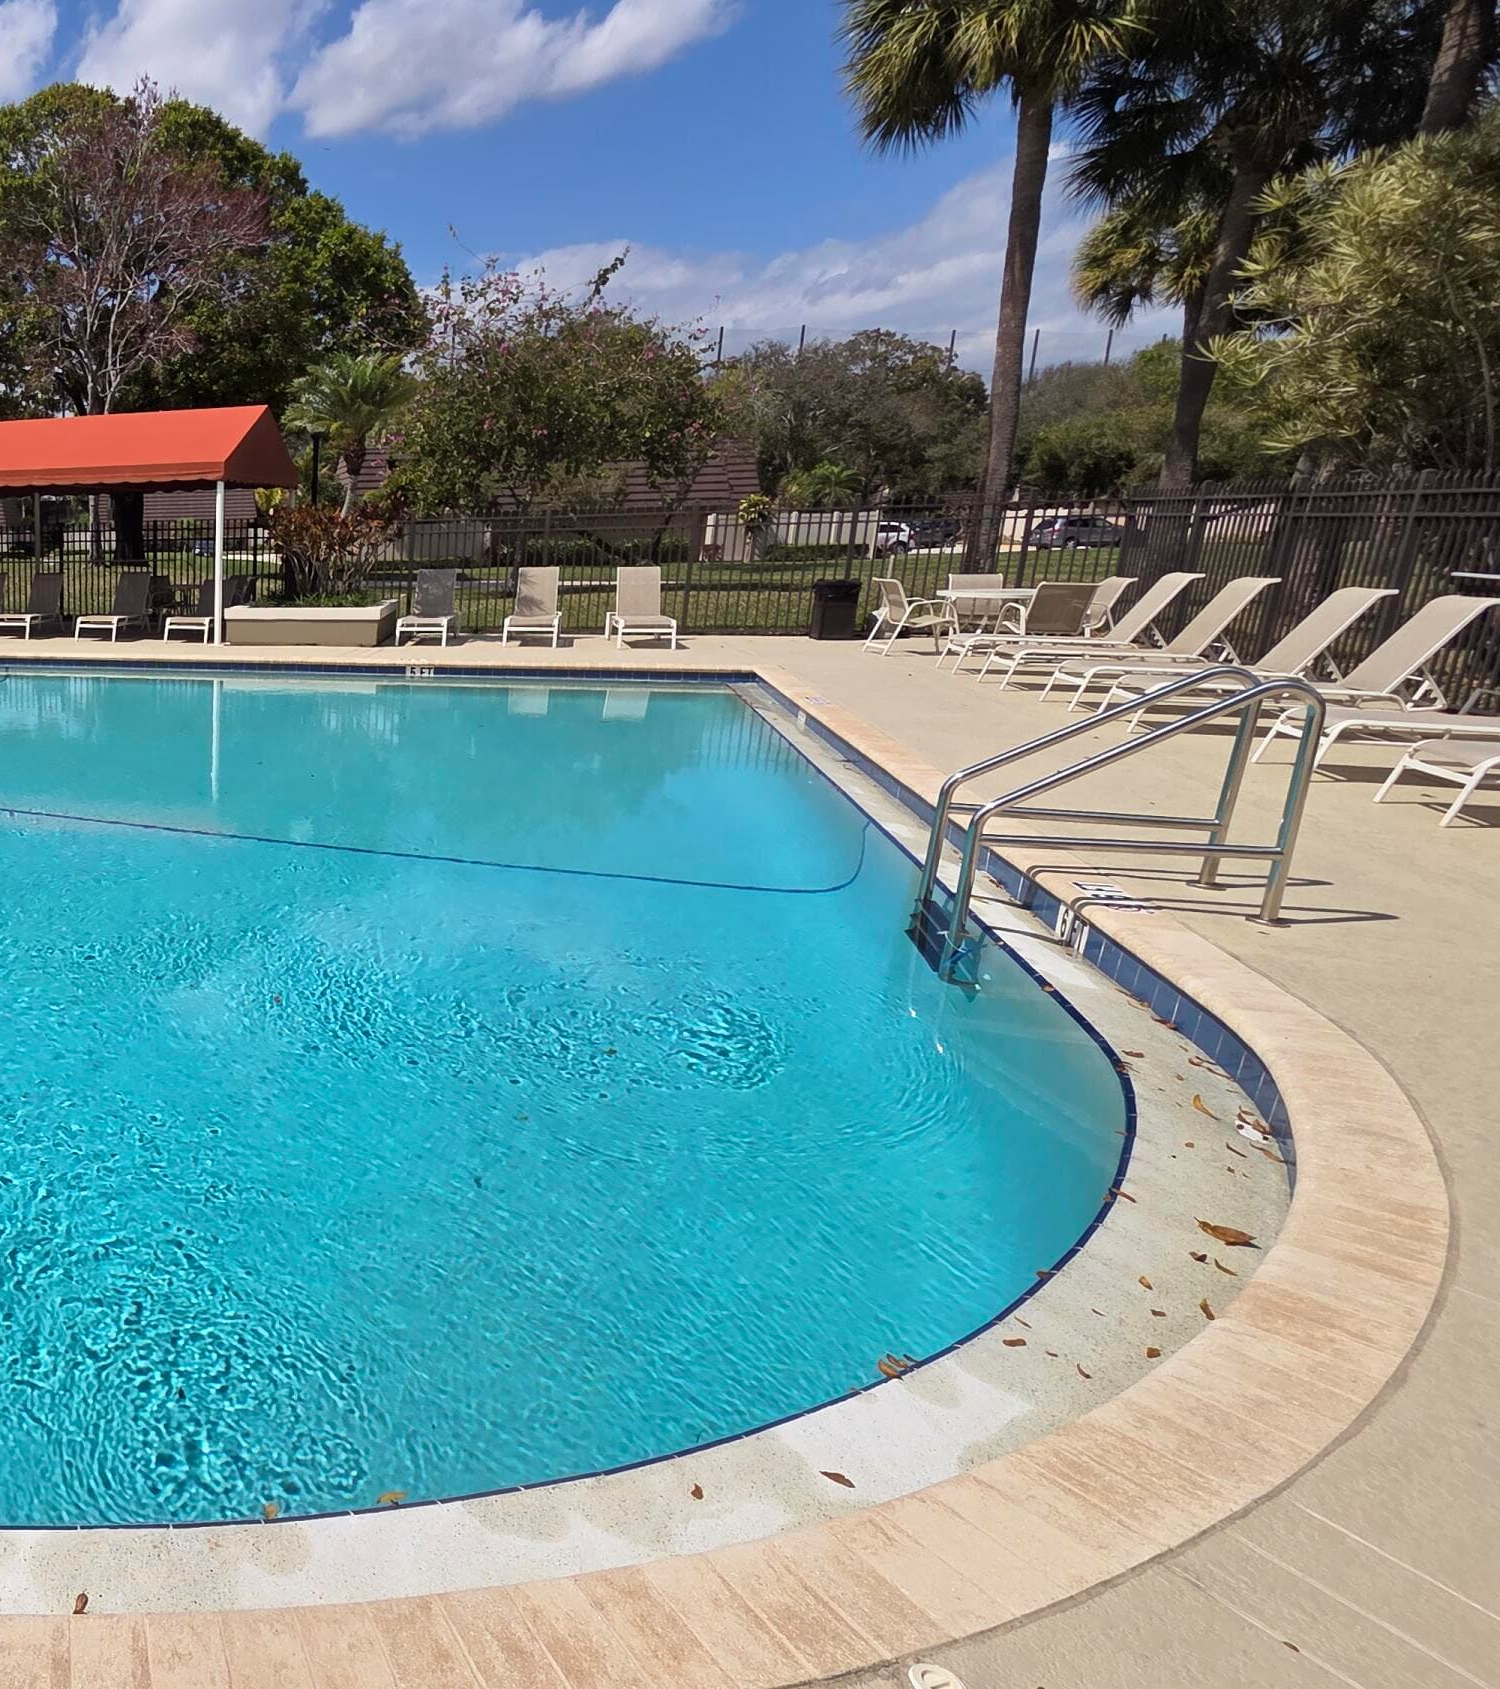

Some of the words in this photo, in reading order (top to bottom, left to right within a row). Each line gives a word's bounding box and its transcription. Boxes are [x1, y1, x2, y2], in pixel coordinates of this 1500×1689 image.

[410, 667, 416, 675] 5
[420, 667, 433, 675] FT
[1060, 907, 1070, 938] 6
[1067, 914, 1088, 951] FT
